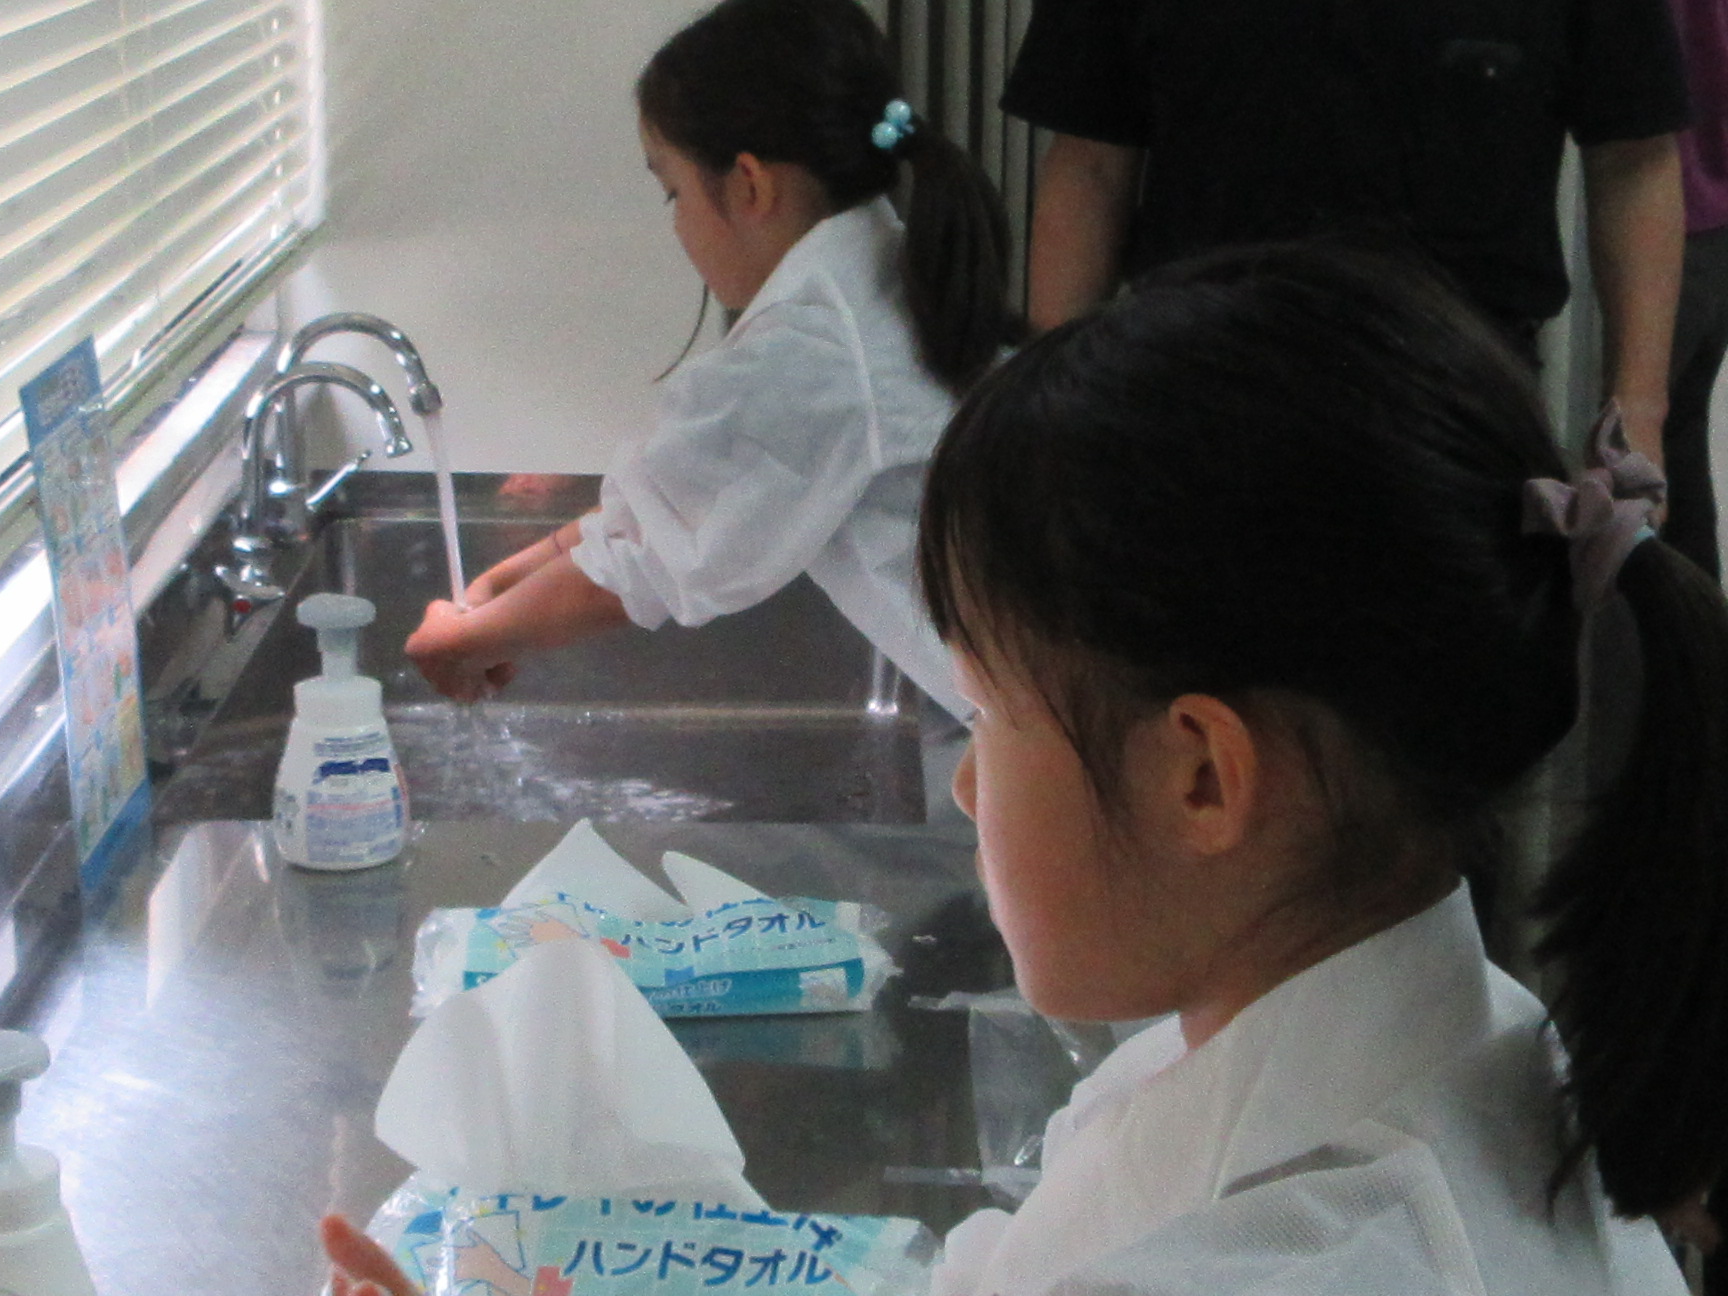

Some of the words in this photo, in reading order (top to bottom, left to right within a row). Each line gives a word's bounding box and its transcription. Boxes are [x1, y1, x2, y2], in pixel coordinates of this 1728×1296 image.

[621, 910, 827, 955] ハンドタオル
[564, 1239, 834, 1288] ハンドタオル
